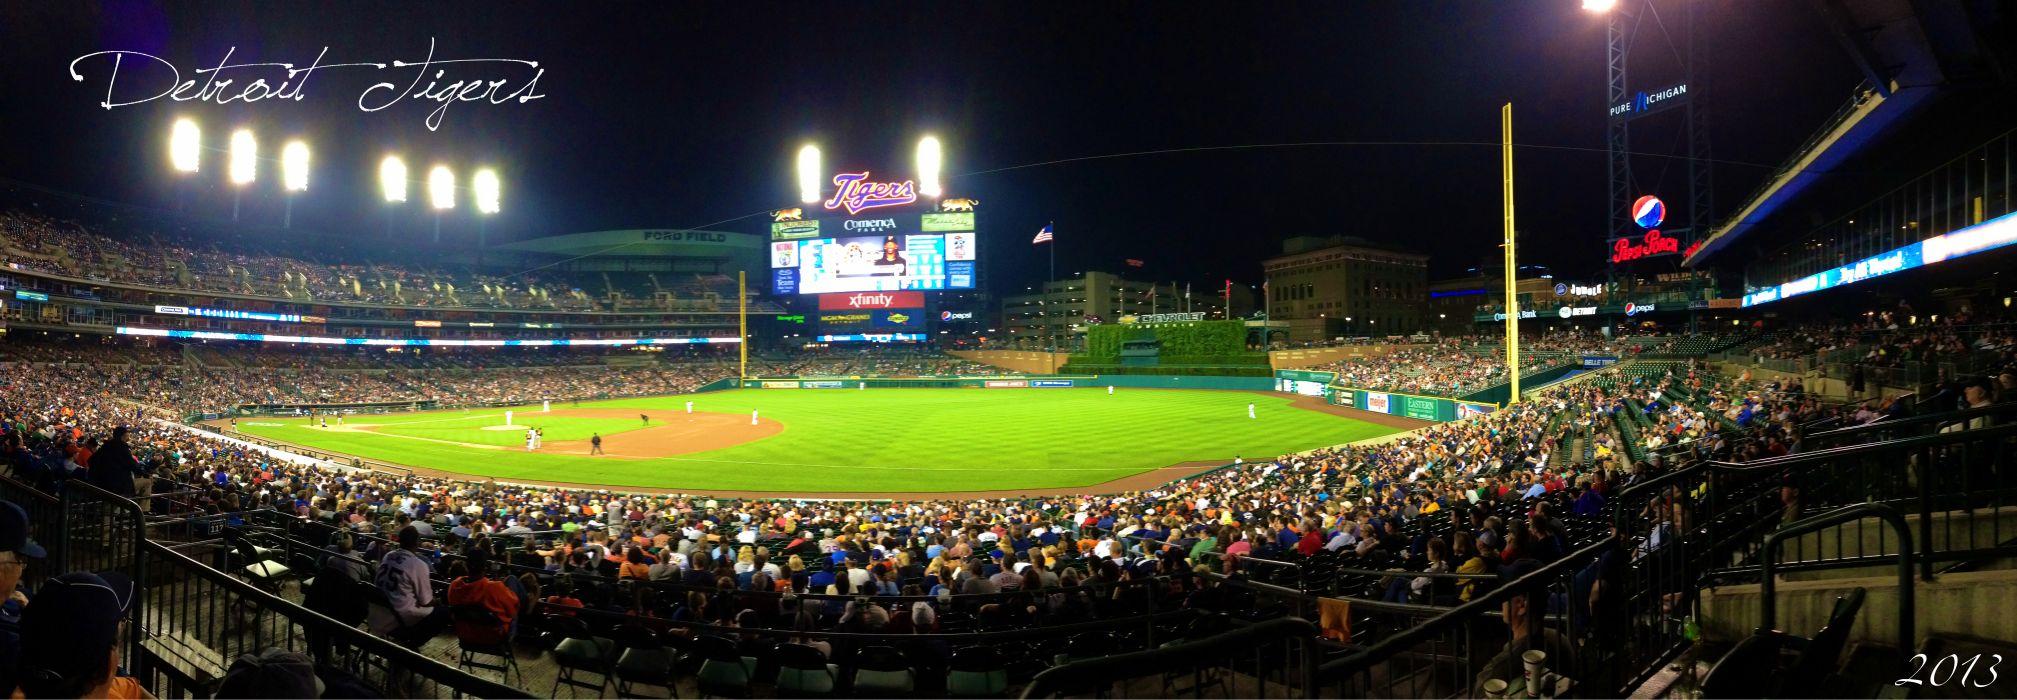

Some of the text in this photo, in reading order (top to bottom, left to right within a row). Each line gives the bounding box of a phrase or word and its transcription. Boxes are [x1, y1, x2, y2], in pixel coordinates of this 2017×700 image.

[1610, 85, 1687, 117] PURE MICHIGAN
[824, 171, 917, 214] Tigers
[644, 231, 726, 242] FORD FIELD
[1570, 283, 1602, 297] JUNGLE
[848, 293, 894, 308] xfinity
[1635, 303, 1655, 313] pepsi
[952, 312, 972, 320] pepsi
[1141, 312, 1207, 323] CHEVROLET
[1521, 310, 1537, 319] Bank
[1369, 396, 1387, 409] meijer
[1407, 397, 1434, 409] EASTERN
